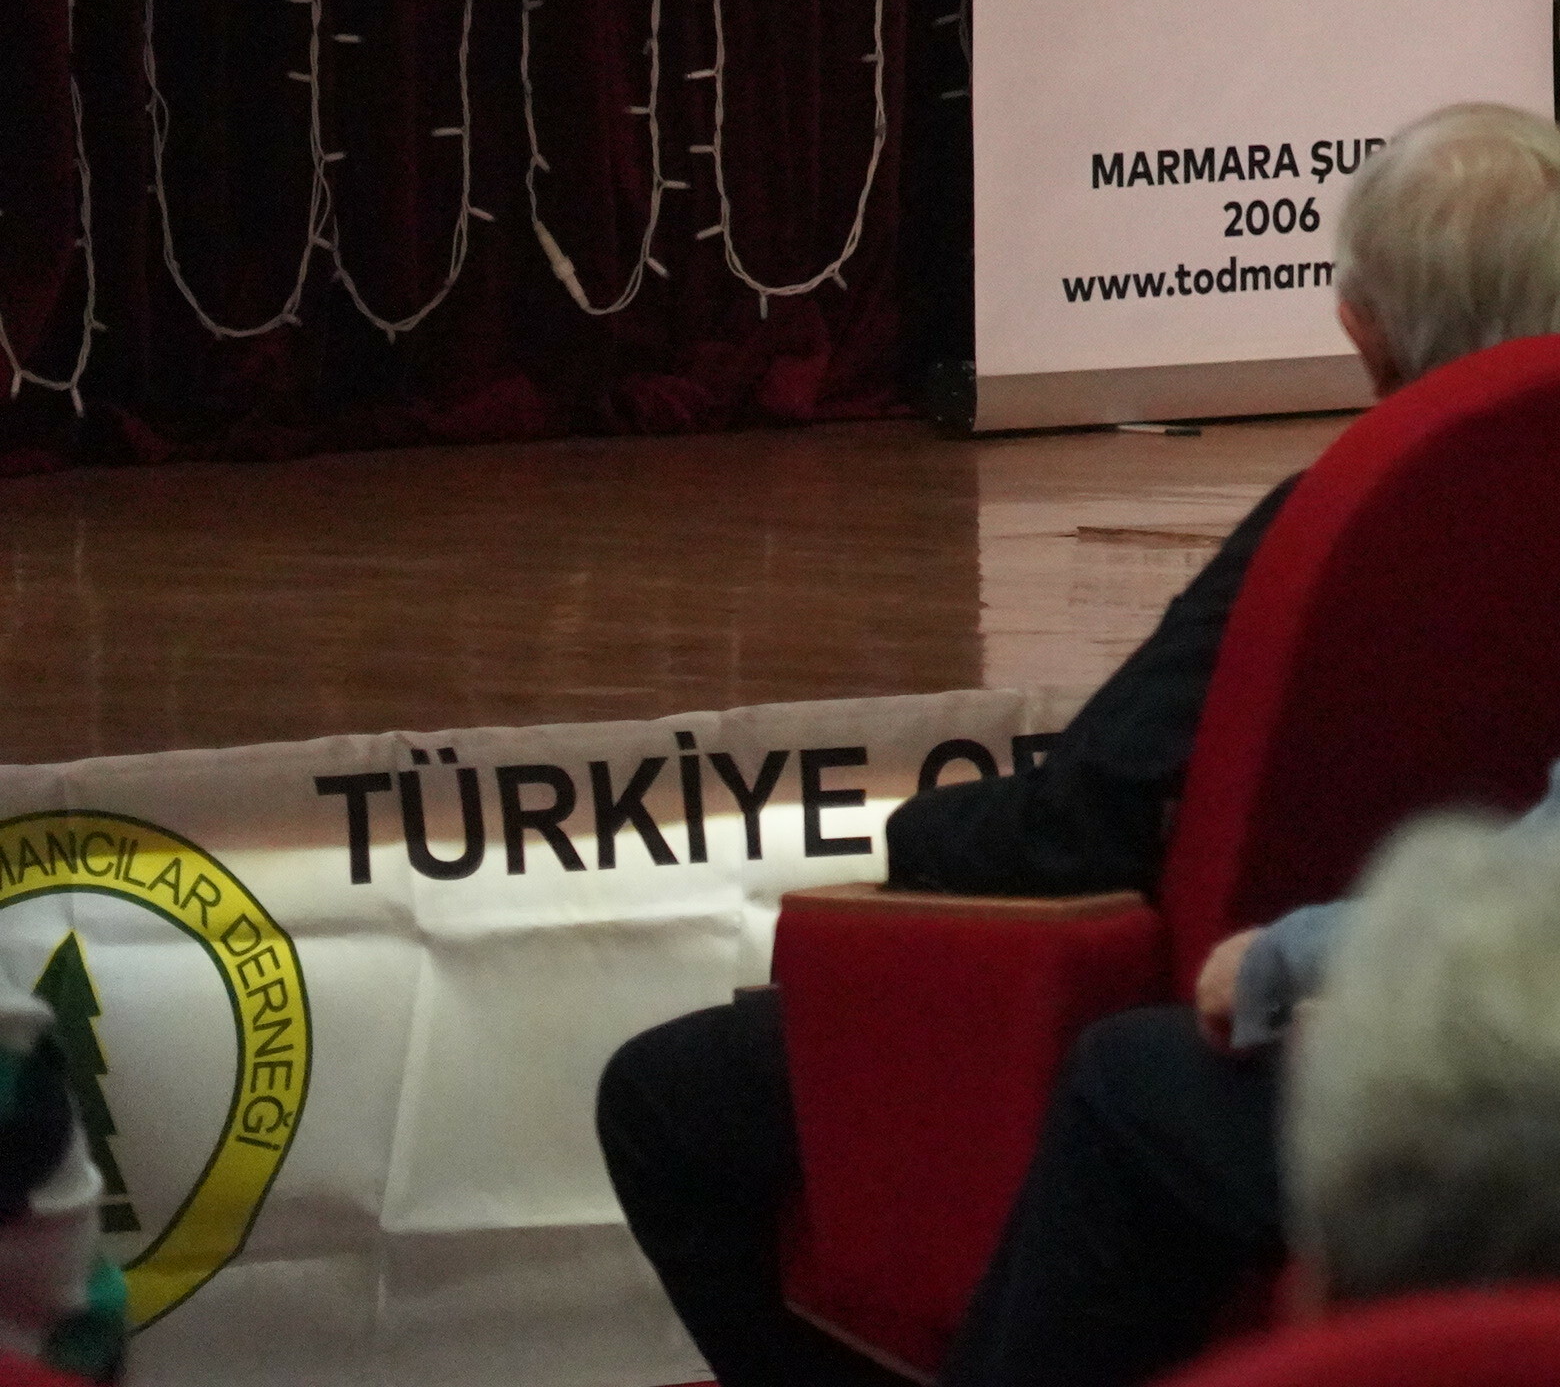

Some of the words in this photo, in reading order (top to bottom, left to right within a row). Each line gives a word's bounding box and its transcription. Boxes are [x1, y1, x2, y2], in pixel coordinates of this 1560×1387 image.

[1092, 143, 1300, 189] MARMARA
[1223, 197, 1321, 238] 2006
[314, 730, 874, 886] TÜRKİYE
[220, 913, 296, 1152] DERNEĞİ
